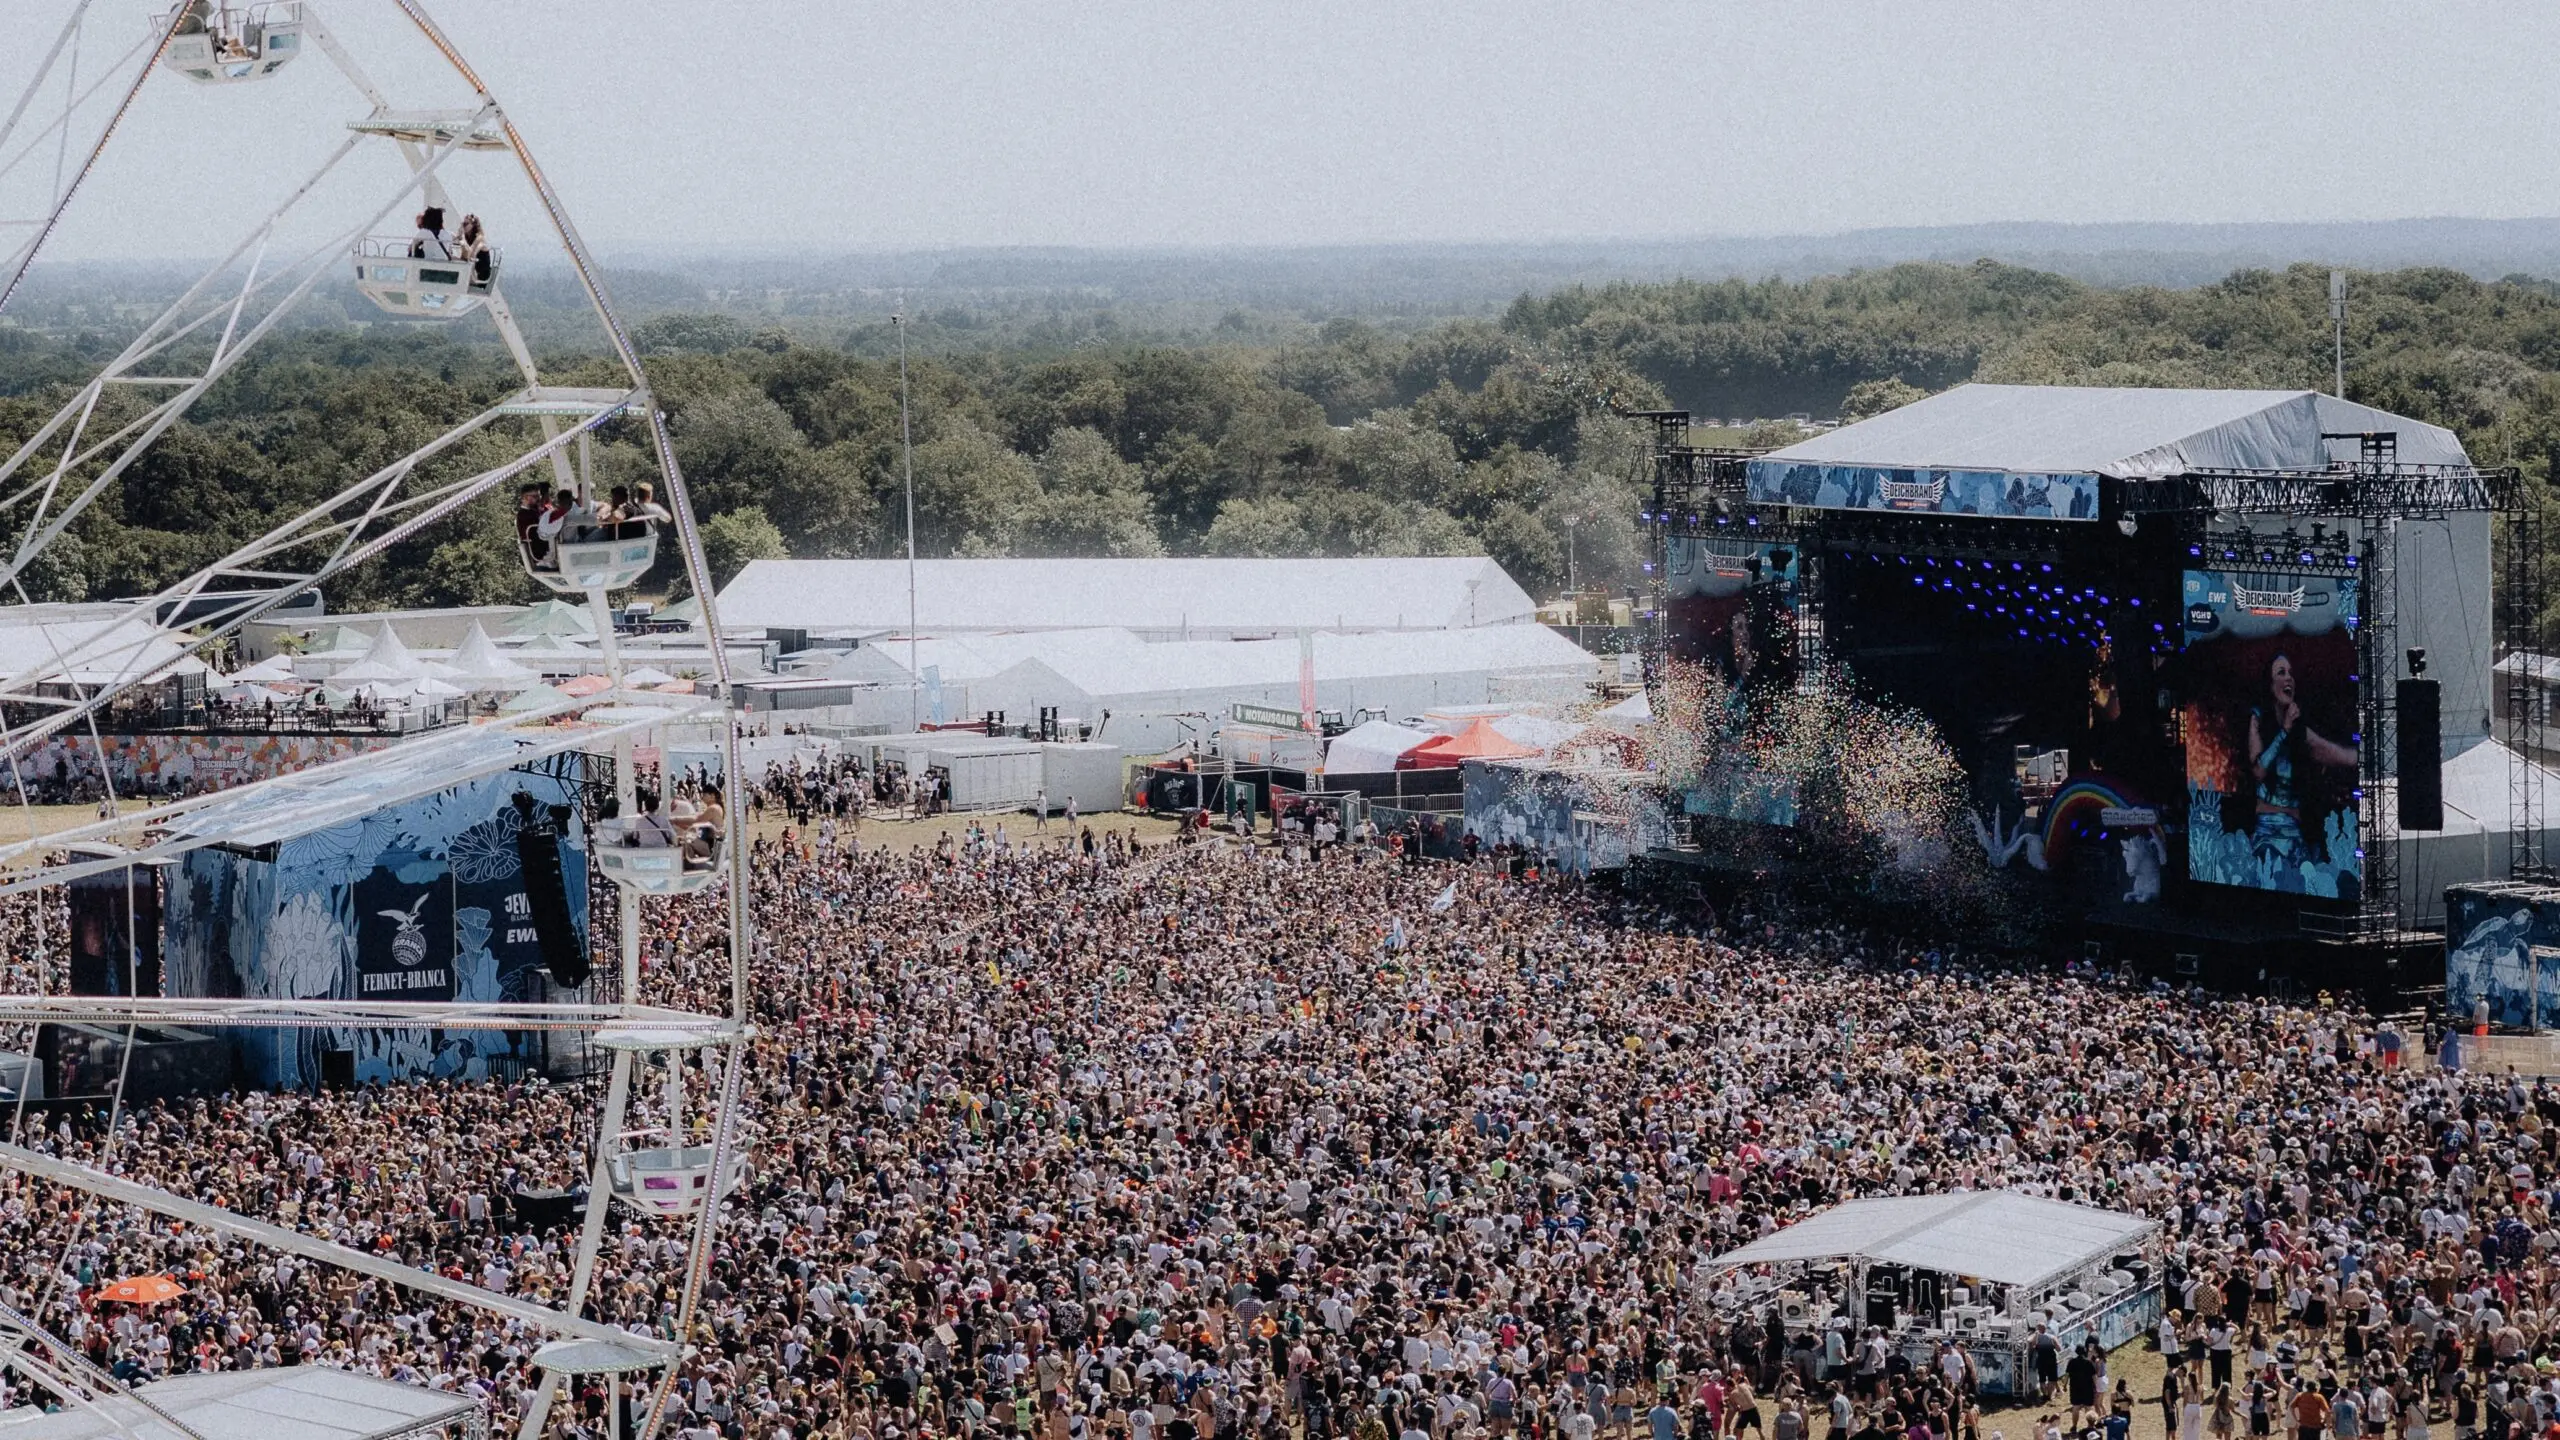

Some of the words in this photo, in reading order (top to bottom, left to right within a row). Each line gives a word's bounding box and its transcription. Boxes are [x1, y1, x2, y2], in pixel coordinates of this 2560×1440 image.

[1889, 484, 1934, 499] DEICHBRAND
[2208, 591, 2227, 604] EWE
[2245, 592, 2293, 608] DEICHBRAND
[1245, 709, 1298, 728] NOTAUSGANG
[504, 892, 531, 915] JEV
[363, 969, 446, 992] FERNET-BRANCA
